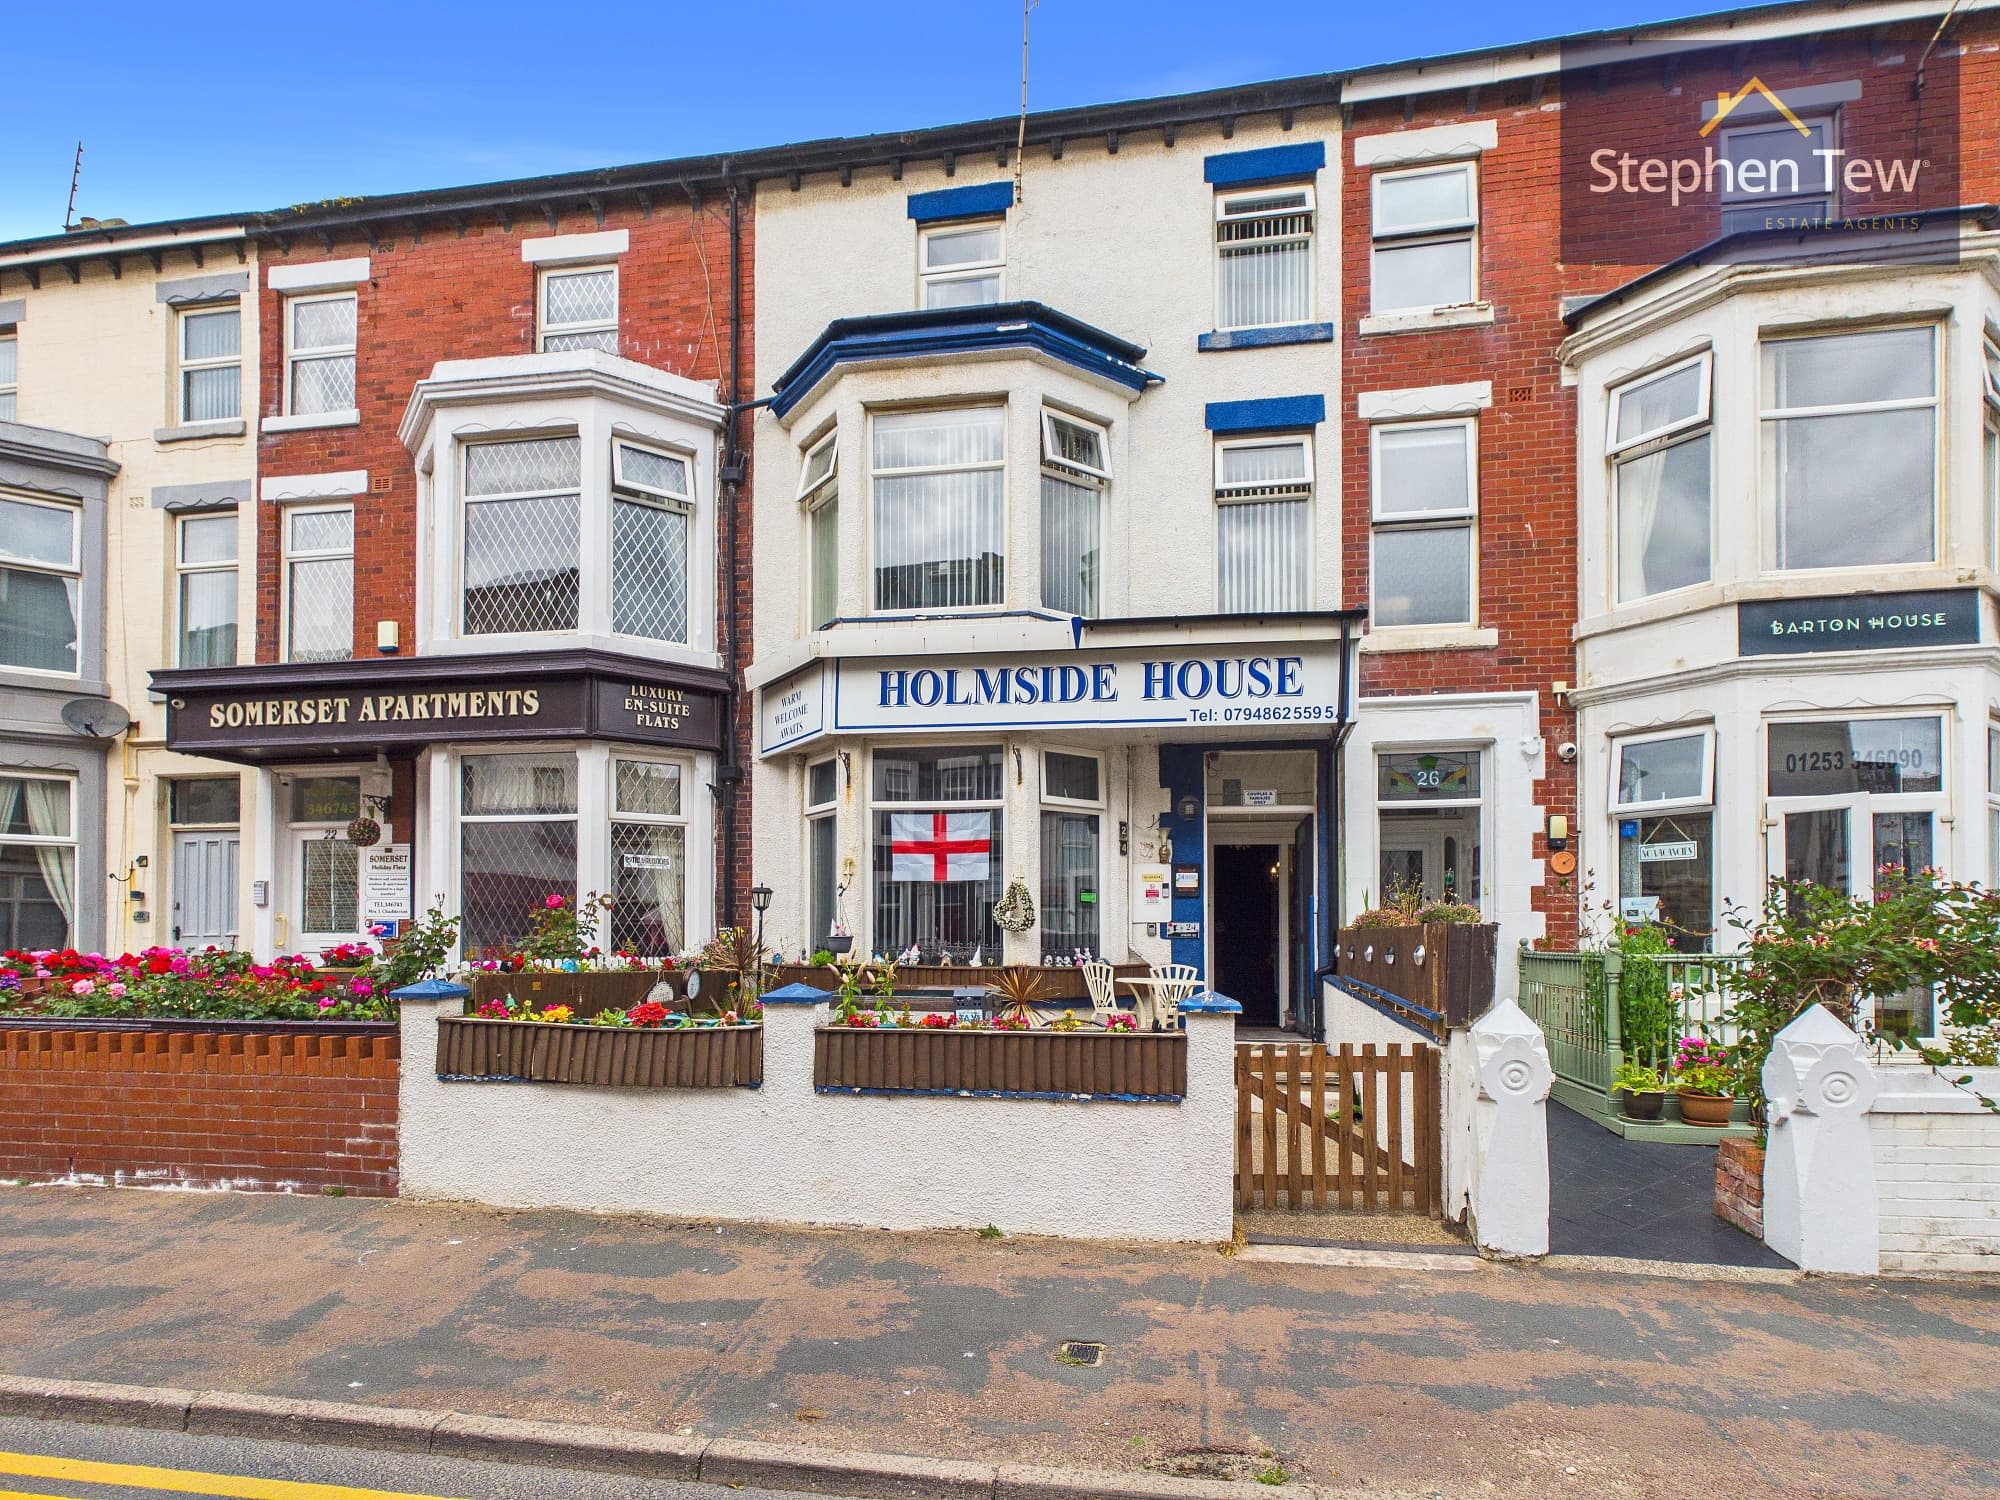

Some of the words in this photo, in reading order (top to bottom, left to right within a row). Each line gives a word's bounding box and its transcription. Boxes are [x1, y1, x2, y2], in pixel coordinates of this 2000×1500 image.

[1771, 618, 1860, 635] BARTON
[1868, 612, 1947, 629] HOUSE
[877, 663, 1118, 708] HOLMSIDE
[1141, 656, 1304, 700] HOUSE
[631, 684, 684, 701] LUXURY
[781, 690, 802, 708] WARM
[209, 697, 350, 729] SOMERSET
[358, 689, 540, 722] APARTMENTS
[624, 698, 690, 716] EN-SUITE
[775, 704, 808, 725] WELCOME
[1190, 708, 1218, 722] Tel:
[1223, 705, 1334, 722] 07948625595
[636, 714, 679, 729] FLATS
[780, 720, 804, 739] AWAITS
[1786, 751, 1844, 773] 01253
[1851, 749, 1923, 770] 346090
[1417, 770, 1440, 786] 26
[324, 829, 337, 840] 22
[369, 855, 408, 863] SOMERSET
